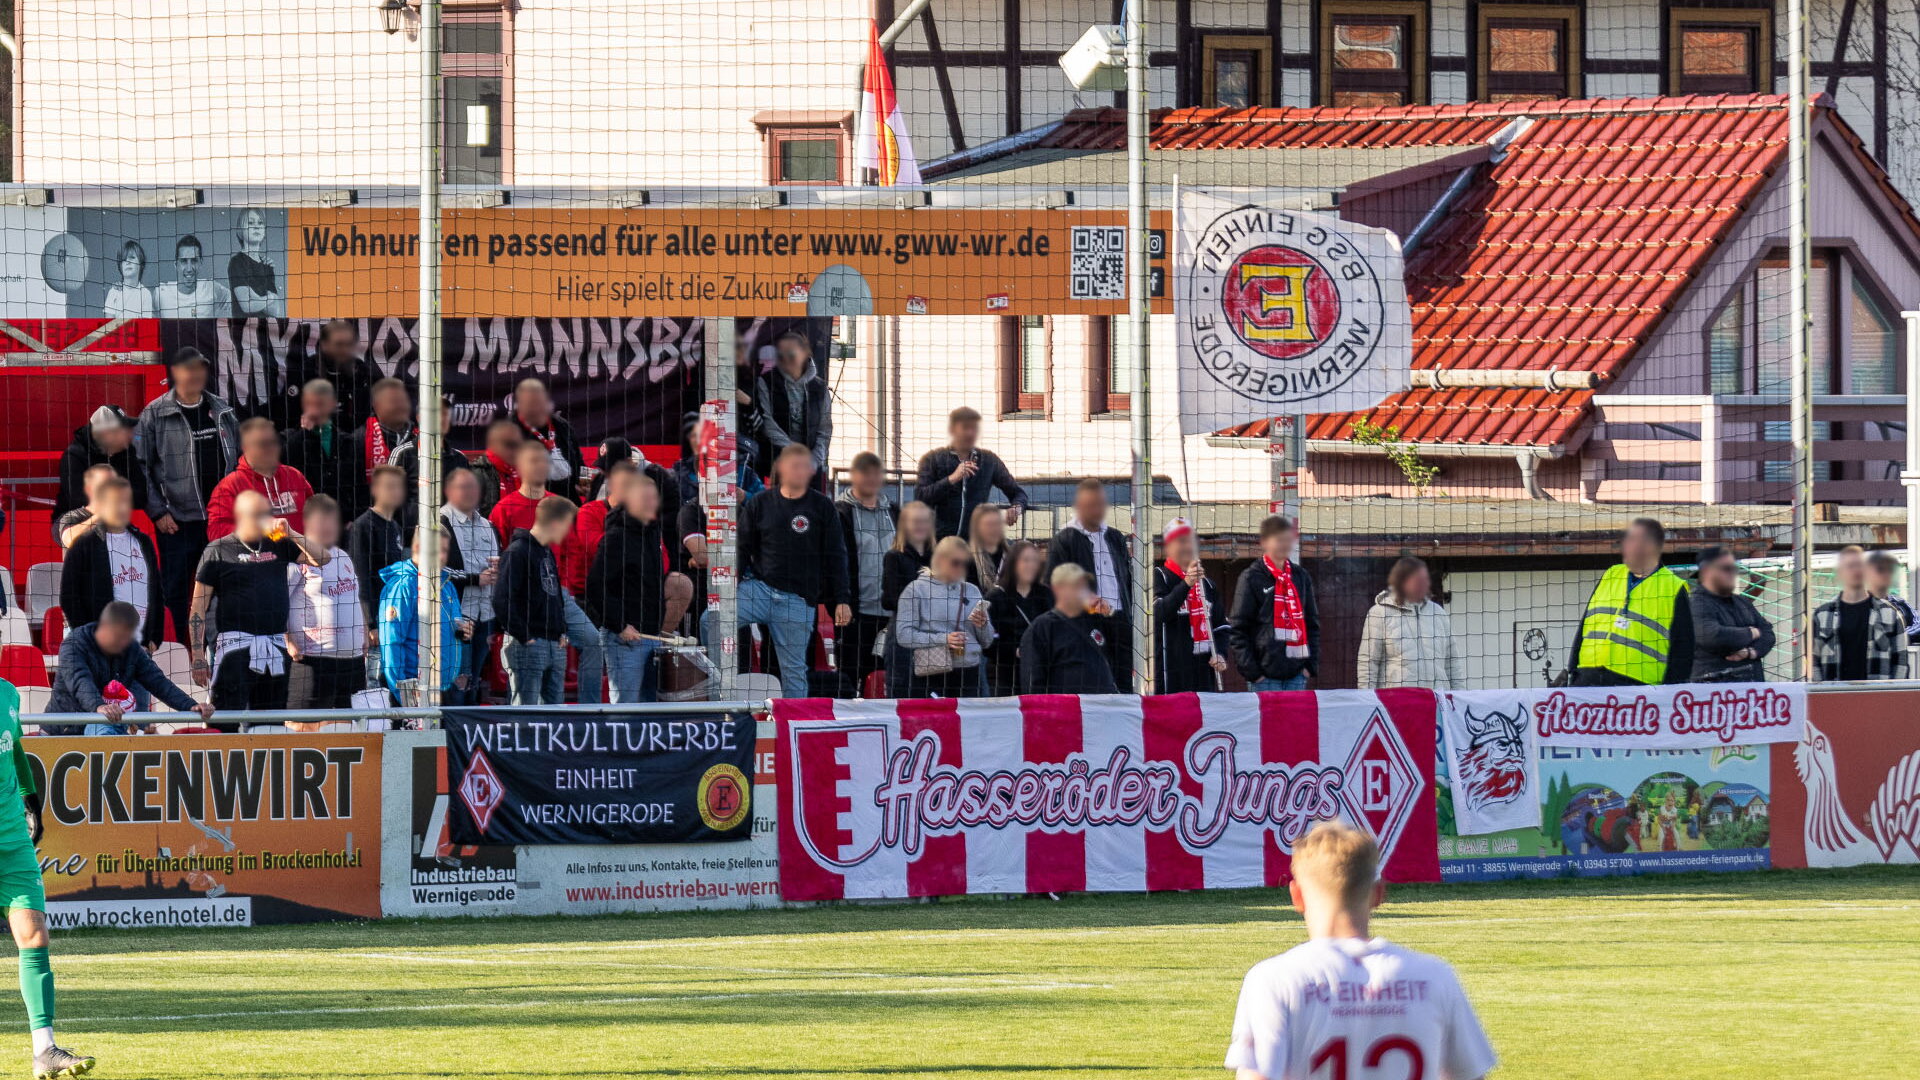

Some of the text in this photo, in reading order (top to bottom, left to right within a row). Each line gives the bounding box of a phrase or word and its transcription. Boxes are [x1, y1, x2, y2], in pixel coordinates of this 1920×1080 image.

[303, 225, 1050, 264] Wohnunen passend für alle unter www.gww-wr.de
[556, 276, 604, 302] Hier
[610, 274, 674, 308] spielt
[681, 274, 715, 301] die
[442, 394, 497, 426] arzer
[1534, 687, 1791, 743] Asoziale Subjekte
[463, 721, 737, 752] WELTKULTURERBE
[555, 768, 637, 789] EINHEIT
[875, 730, 1345, 855] Hasseröder Jungs
[520, 803, 675, 824] WERNIGERODE
[96, 853, 119, 873] für
[123, 848, 234, 875] Übernachtung
[238, 851, 257, 870] im
[566, 862, 585, 874] Alle
[587, 862, 612, 874] Infos
[614, 865, 626, 873] zu
[628, 864, 649, 875] uns,
[651, 860, 700, 874] Kontakte,
[702, 858, 726, 871] freie
[728, 857, 762, 870] Stellen
[1439, 852, 1764, 875] seltal 11 38855 Wernigerode Tel. 03943 55700 www.hasseroeder-ferienpark.de
[411, 866, 516, 882] Industriebau
[412, 884, 516, 905] Wernigeode
[566, 880, 779, 902] www.industriebau-wern
[47, 904, 246, 928] ww.brockenhotel.de
